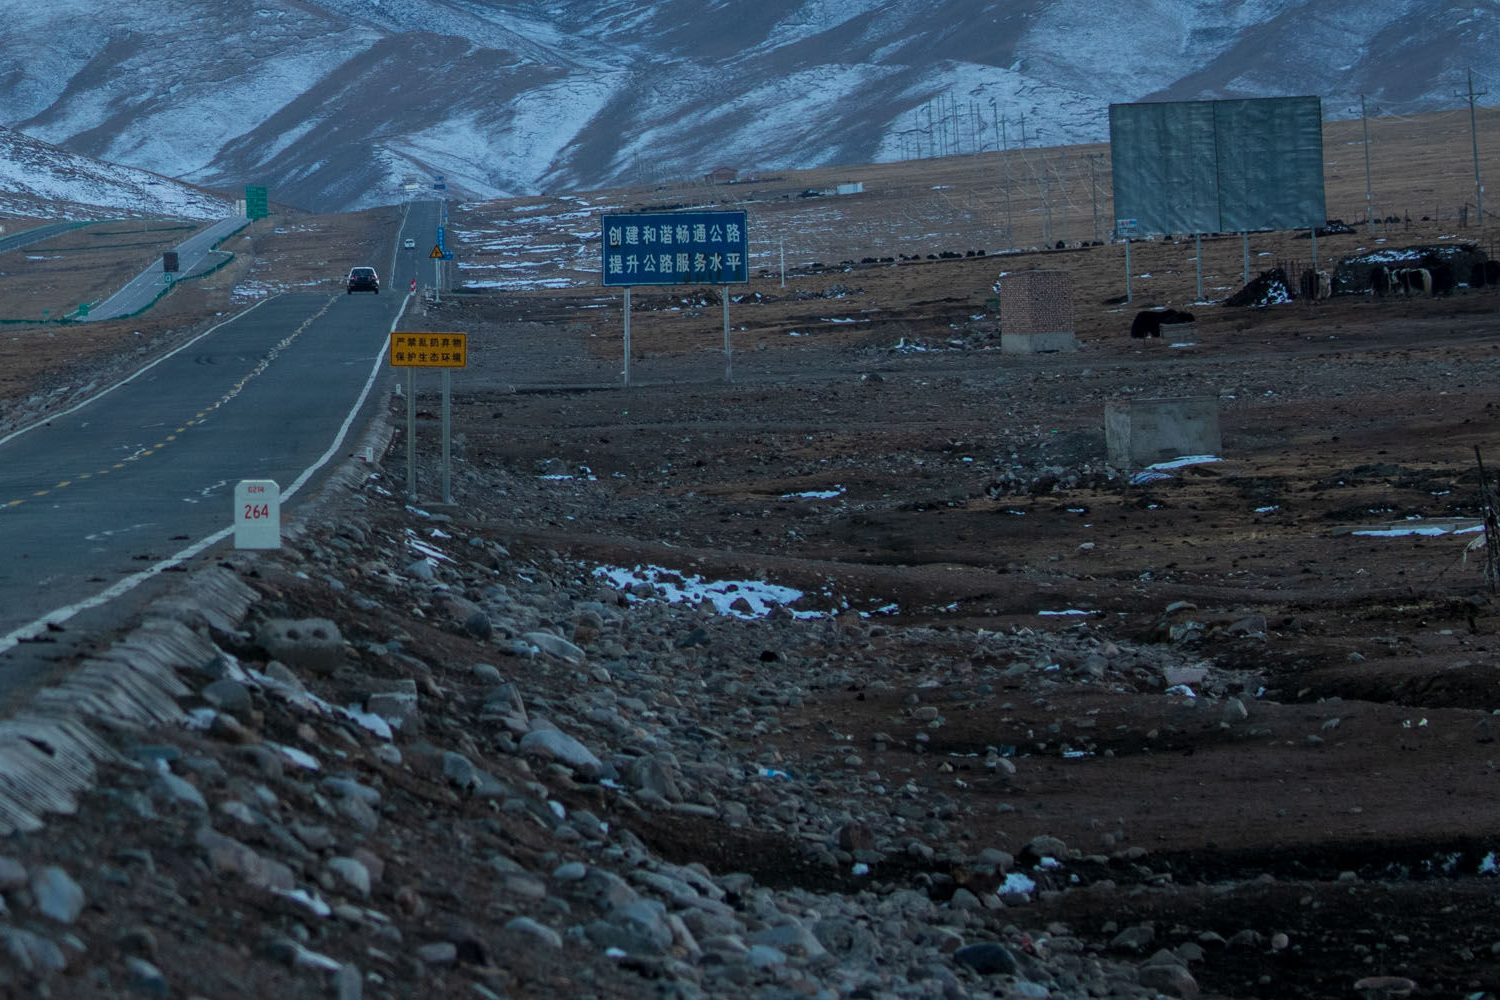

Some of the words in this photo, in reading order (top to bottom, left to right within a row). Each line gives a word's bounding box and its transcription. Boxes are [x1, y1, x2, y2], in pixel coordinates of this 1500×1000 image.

[609, 224, 741, 245] 创建和谐畅通公路
[609, 252, 741, 274] 提升公路服务水平
[396, 352, 462, 362] 保护生态环境
[244, 503, 268, 520] 264
